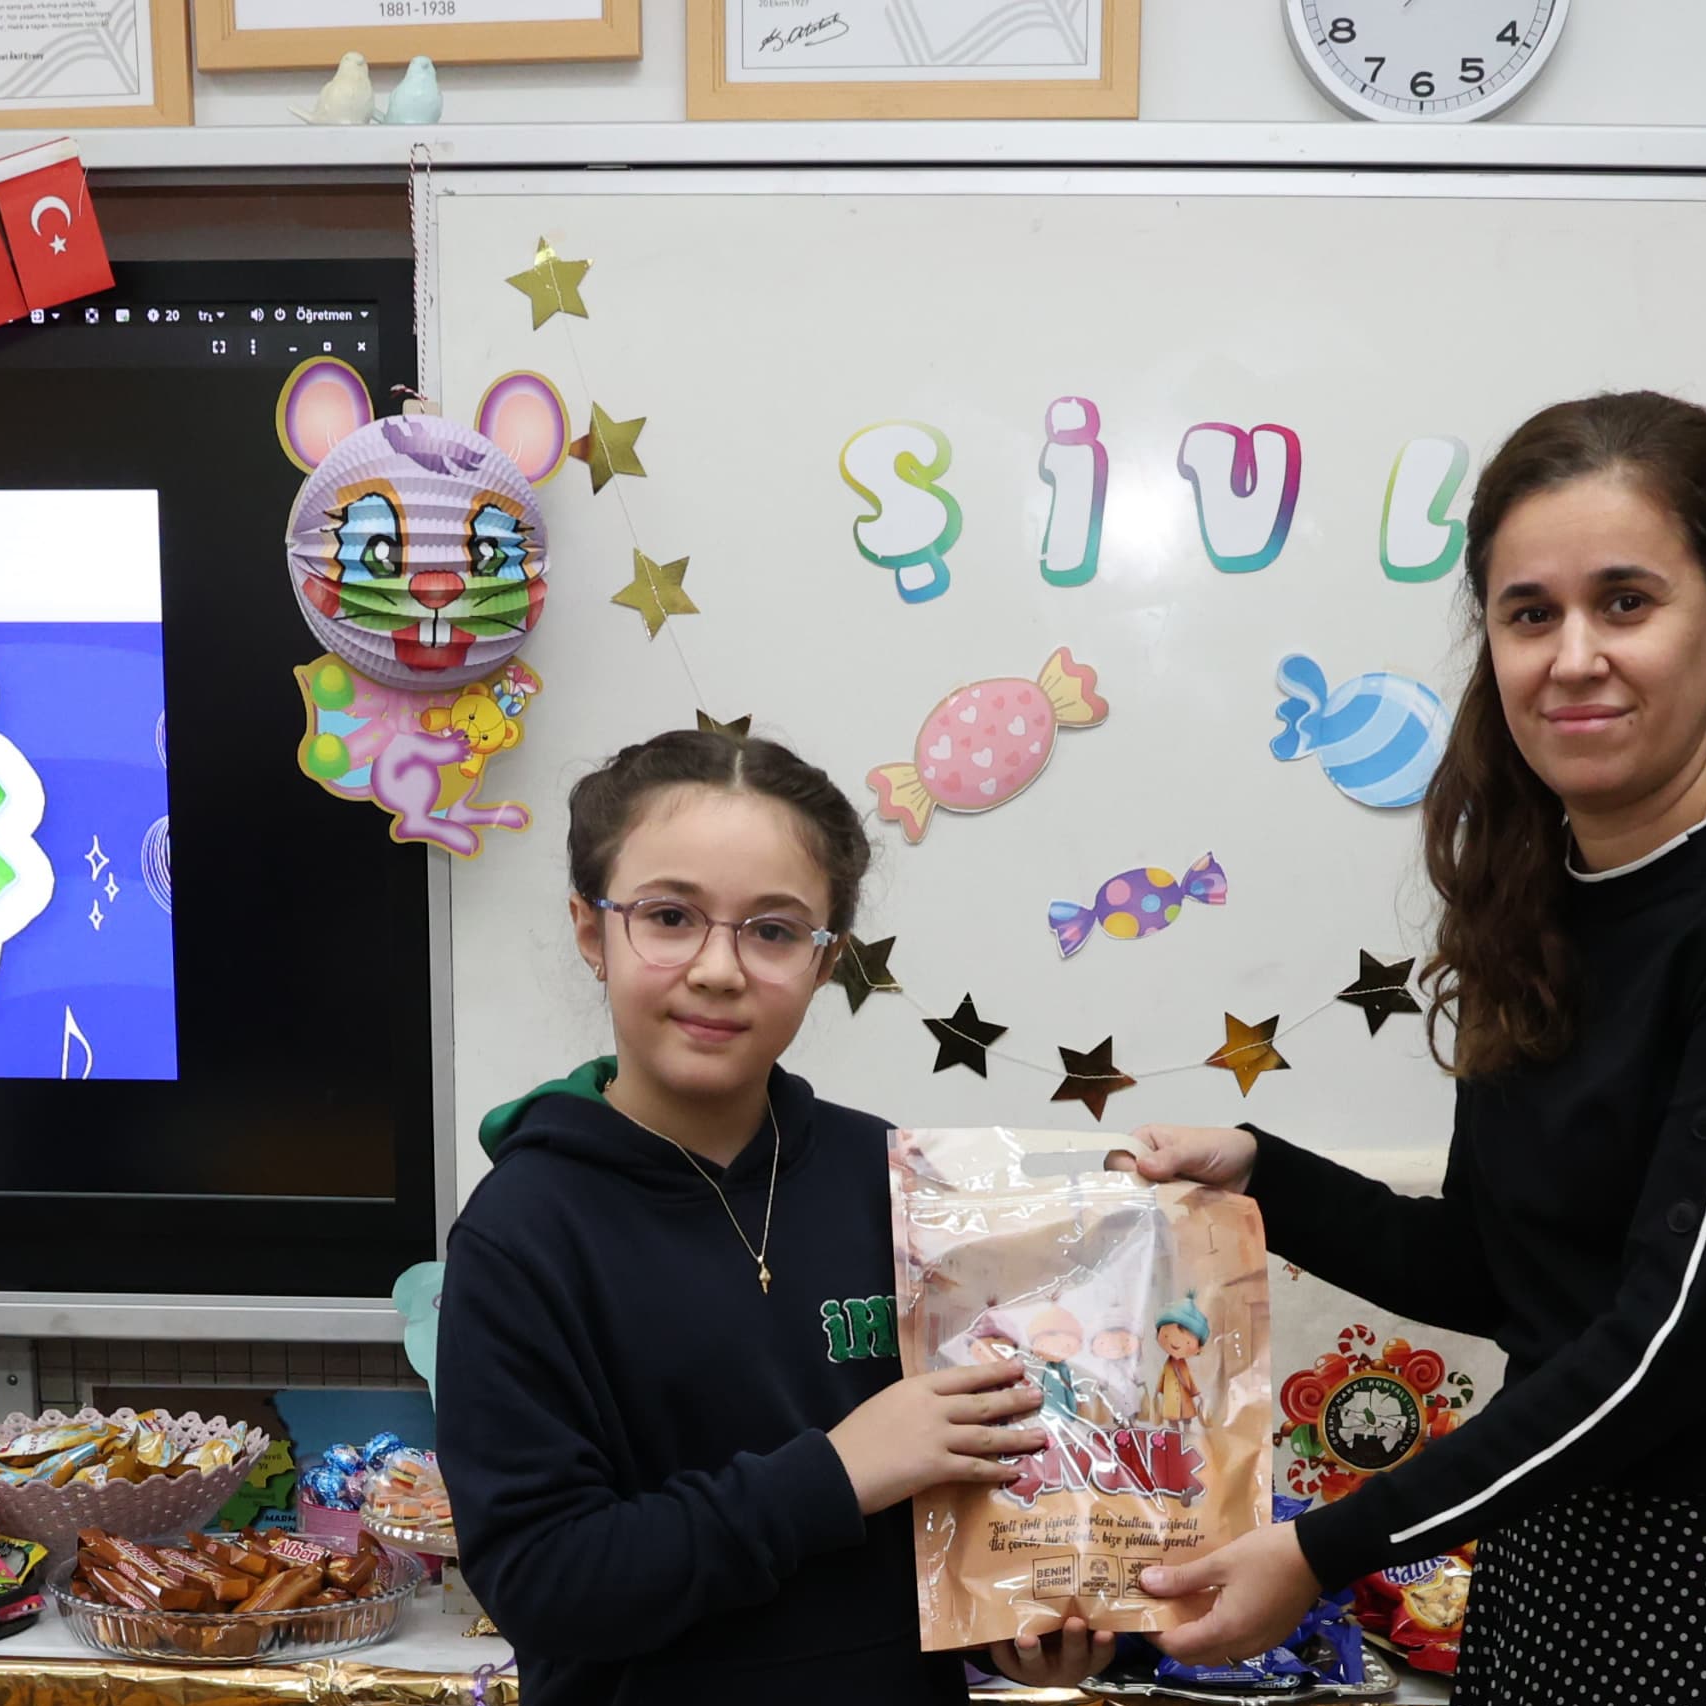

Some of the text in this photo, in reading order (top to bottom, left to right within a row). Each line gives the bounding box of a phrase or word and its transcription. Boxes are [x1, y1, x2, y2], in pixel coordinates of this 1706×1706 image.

[1328, 17, 1356, 44] 8
[1495, 20, 1521, 46] 4
[1364, 57, 1386, 83] 7
[1459, 57, 1485, 83] 5
[1409, 71, 1435, 98] 6
[165, 310, 180, 322] 20
[295, 307, 353, 324] Öğretmen
[1036, 1566, 1072, 1579] BENİM
[1036, 1577, 1072, 1590] ŞEHRİM
